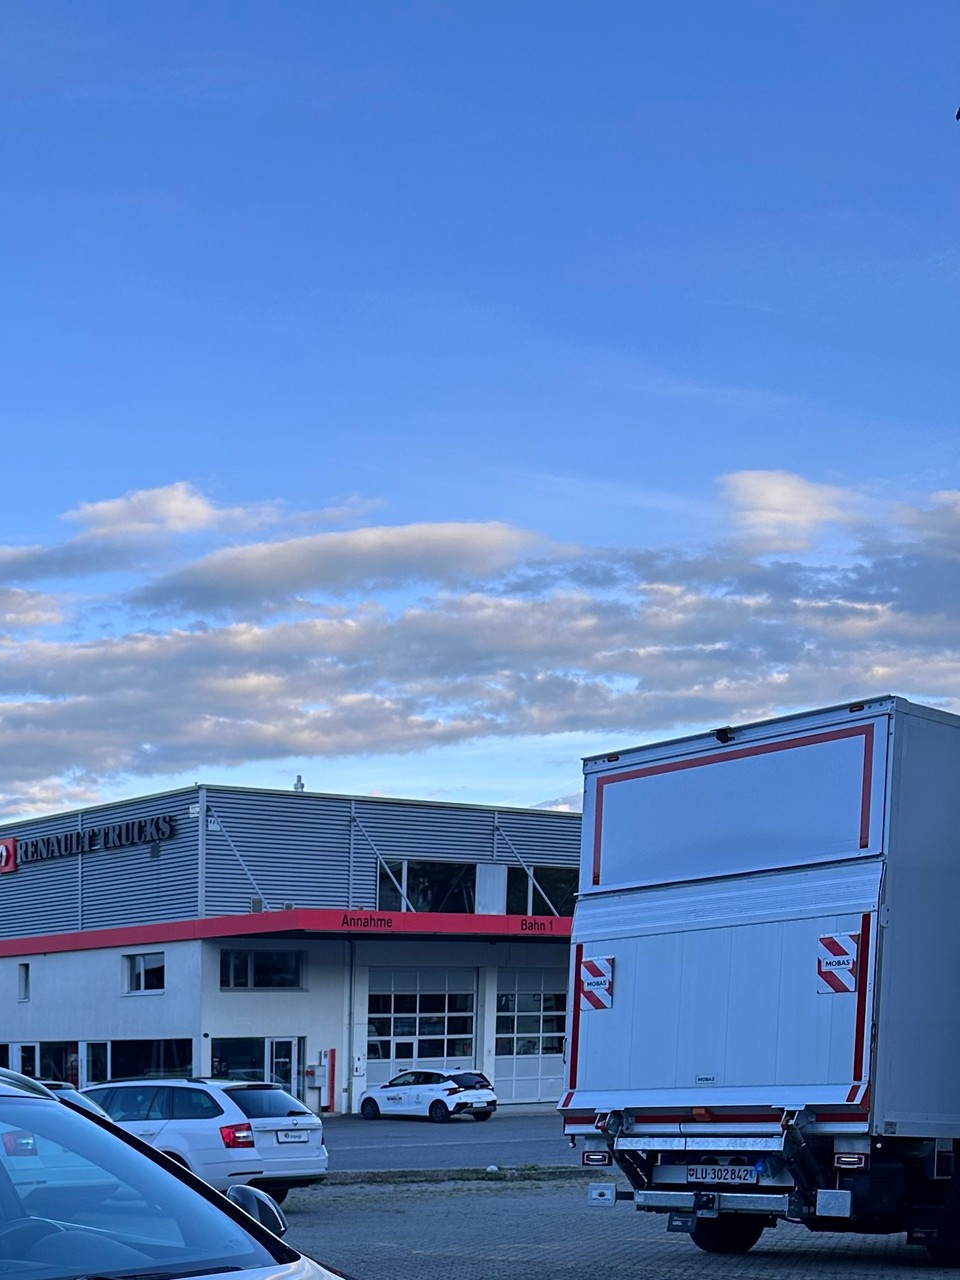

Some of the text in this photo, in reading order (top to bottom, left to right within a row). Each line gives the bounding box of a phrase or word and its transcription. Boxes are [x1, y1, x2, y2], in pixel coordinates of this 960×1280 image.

[15, 815, 174, 864] RENAULT TRUCKS
[341, 914, 393, 928] Annahme
[520, 918, 553, 931] Bahn 1
[825, 959, 850, 967] MOBAS
